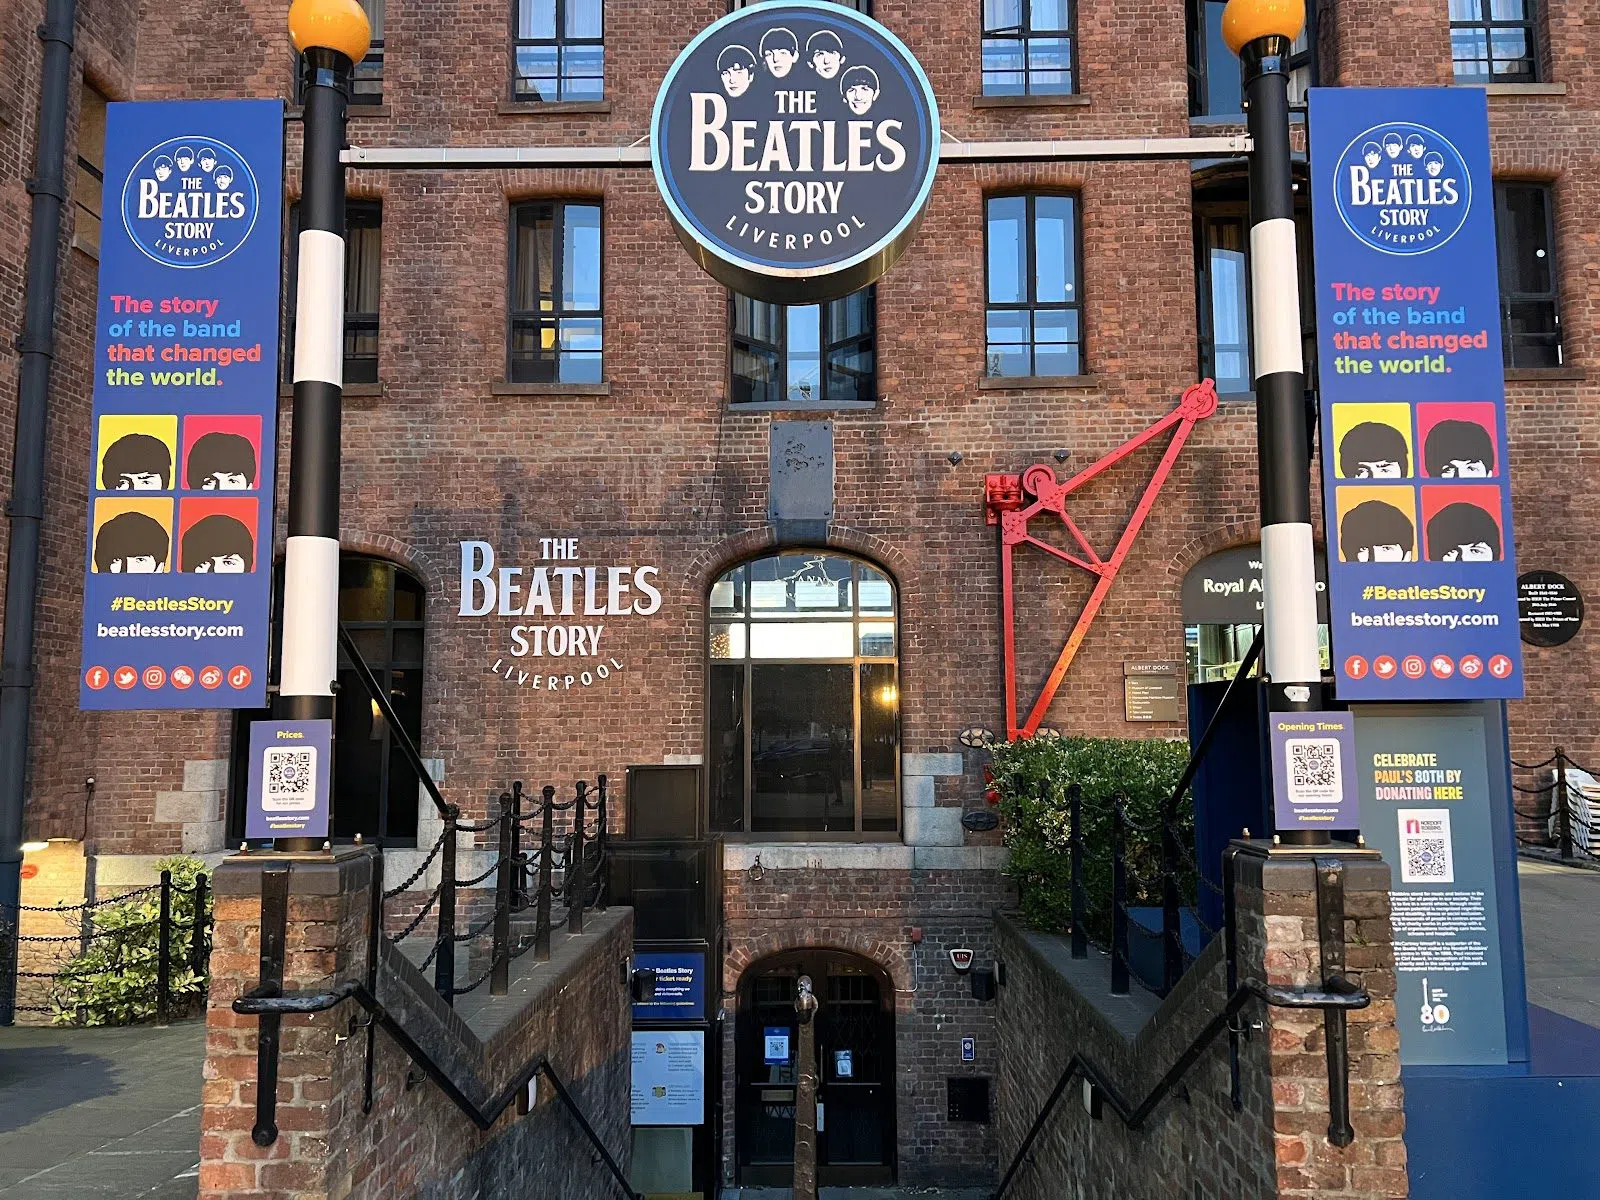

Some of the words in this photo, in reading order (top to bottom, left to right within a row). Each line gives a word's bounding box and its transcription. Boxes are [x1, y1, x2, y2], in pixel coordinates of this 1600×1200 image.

[774, 90, 817, 113] THE
[688, 92, 906, 172] BEATLES
[1391, 163, 1413, 176] THE
[181, 177, 202, 190] THE
[1350, 165, 1459, 206] BEATLES
[138, 178, 246, 219] BEATLES
[745, 181, 844, 214] STORY
[1379, 208, 1429, 226] STORY
[164, 222, 214, 239] STORY
[725, 215, 866, 250] LIVERPOOL
[1370, 225, 1441, 243] LIVERPOOL
[153, 238, 225, 257] LIVERPOOL
[1331, 283, 1376, 301] The
[1382, 283, 1440, 305] story
[110, 295, 153, 313] The
[160, 296, 218, 318] story
[1333, 307, 1357, 325] of
[1362, 307, 1400, 325] the
[1407, 307, 1465, 325] band
[108, 320, 134, 338] of
[138, 320, 176, 338] the
[183, 320, 241, 338] band
[1333, 332, 1381, 349] that
[1388, 331, 1488, 353] changed
[107, 344, 154, 362] that
[160, 343, 261, 366] changed
[1335, 356, 1373, 374] the
[1379, 355, 1452, 374] world.
[106, 368, 144, 386] the
[151, 367, 224, 386] world.
[539, 537, 579, 560] THE
[457, 540, 663, 617] BEATLES
[1203, 578, 1244, 597] Royal
[1361, 585, 1486, 603] #BeatlesStory
[111, 596, 234, 614] #BeatlesStory
[1351, 612, 1499, 629] beatlesstory.com
[97, 623, 244, 640] beatlesstory.com
[510, 625, 604, 657] STORY
[491, 657, 624, 691] LIVERPOOL
[1278, 722, 1315, 732] Opening
[1373, 753, 1437, 767] CELEBRATE
[1374, 769, 1413, 784] PAUL'S
[1415, 769, 1444, 784] 80TH
[1446, 769, 1462, 783] BY
[1375, 786, 1432, 800] DONATING
[1434, 786, 1464, 800] HERE
